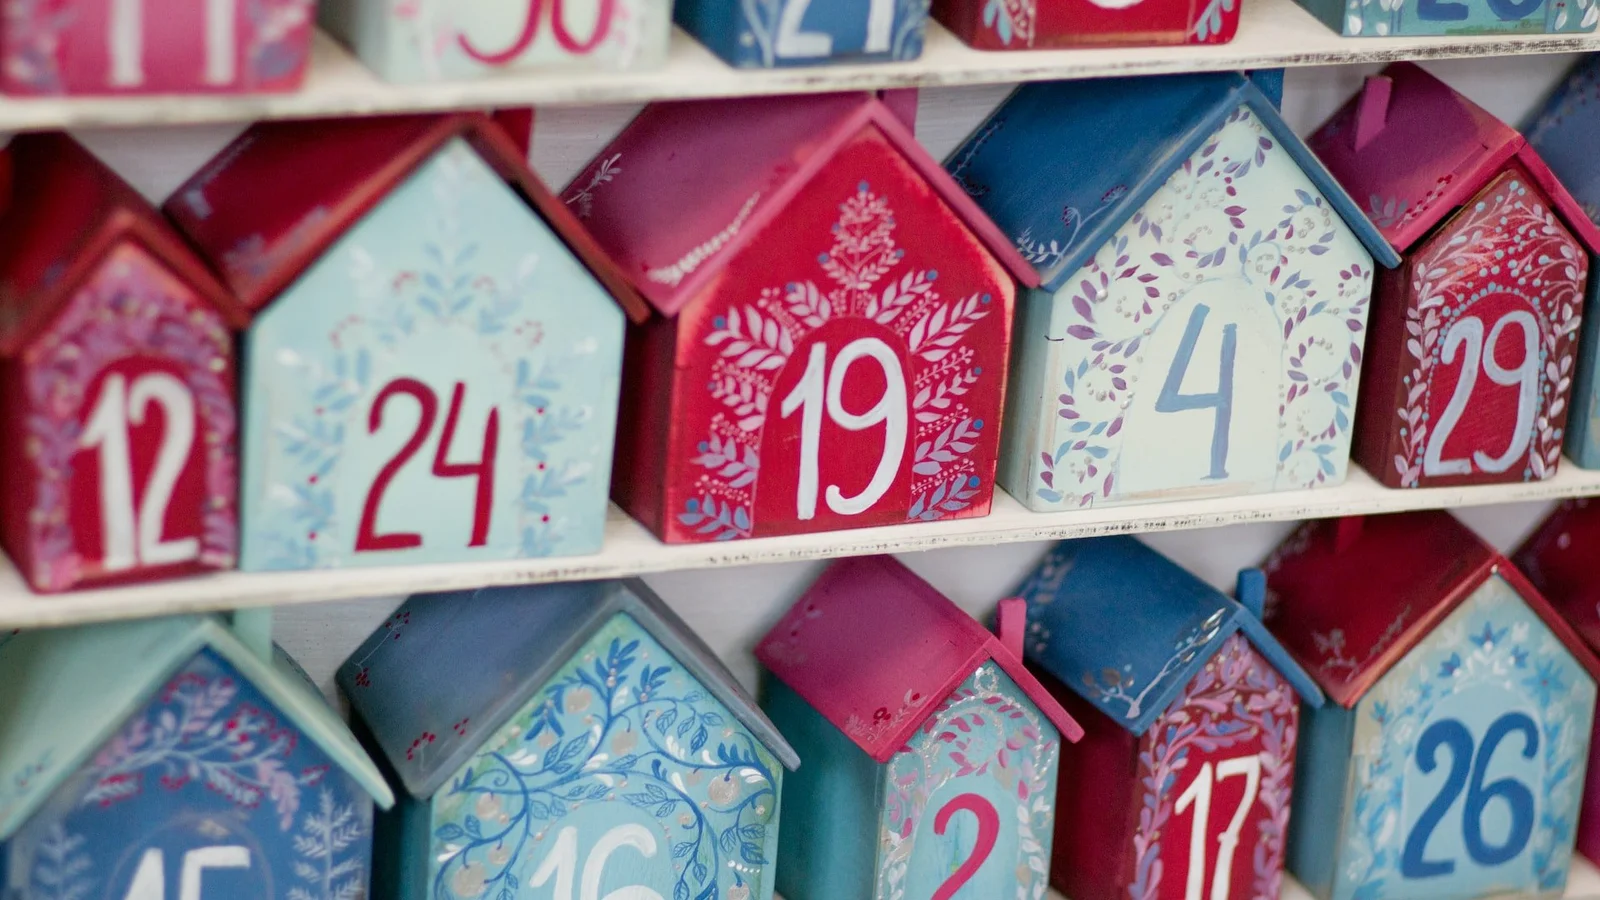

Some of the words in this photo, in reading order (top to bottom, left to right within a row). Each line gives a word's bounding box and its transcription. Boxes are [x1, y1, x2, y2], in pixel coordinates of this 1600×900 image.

[78, 372, 199, 571] 12
[354, 376, 500, 553] 24
[781, 337, 908, 520] 19
[1155, 303, 1237, 480] 4
[1423, 310, 1540, 477] 29
[1175, 754, 1261, 900] 17
[1402, 711, 1539, 878] 26
